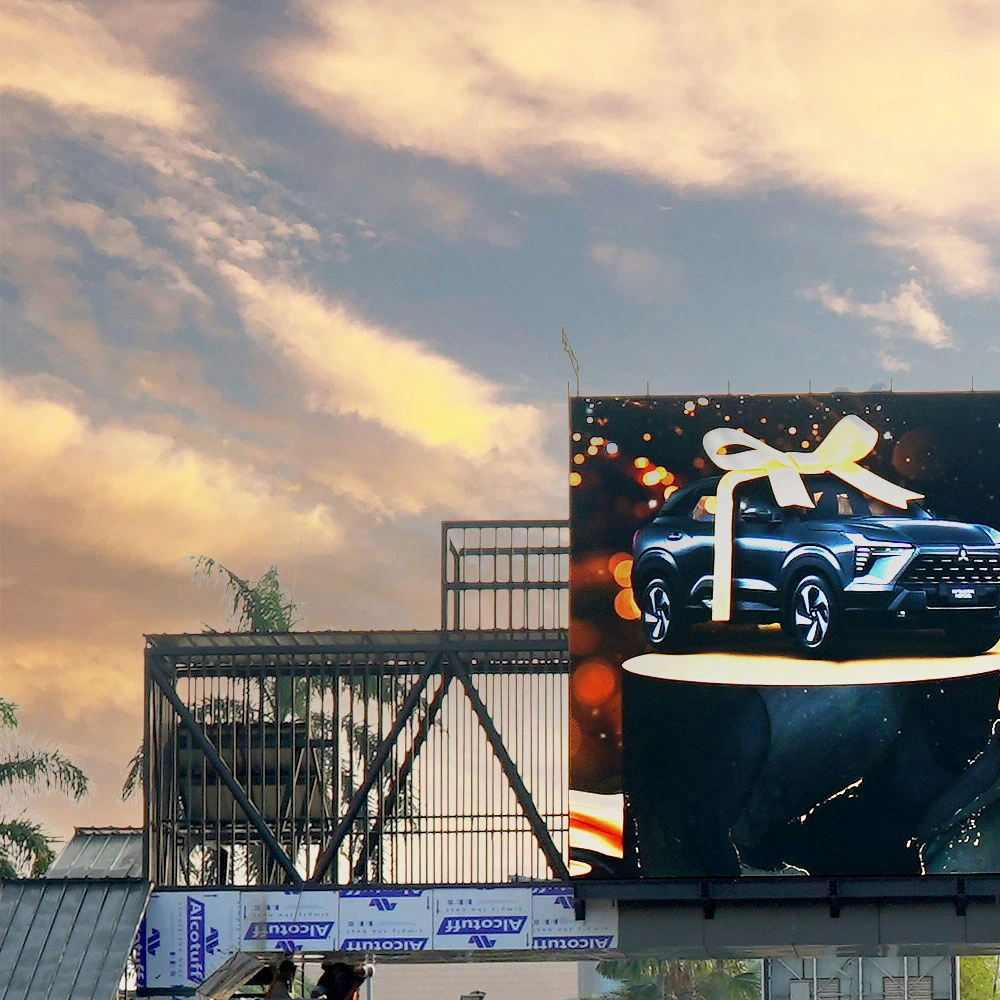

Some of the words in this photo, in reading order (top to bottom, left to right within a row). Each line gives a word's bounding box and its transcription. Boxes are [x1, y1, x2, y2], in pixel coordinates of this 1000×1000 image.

[251, 923, 330, 938] Alcotuff
[445, 918, 523, 932] Alcotuff
[188, 900, 203, 980] Alcotuff
